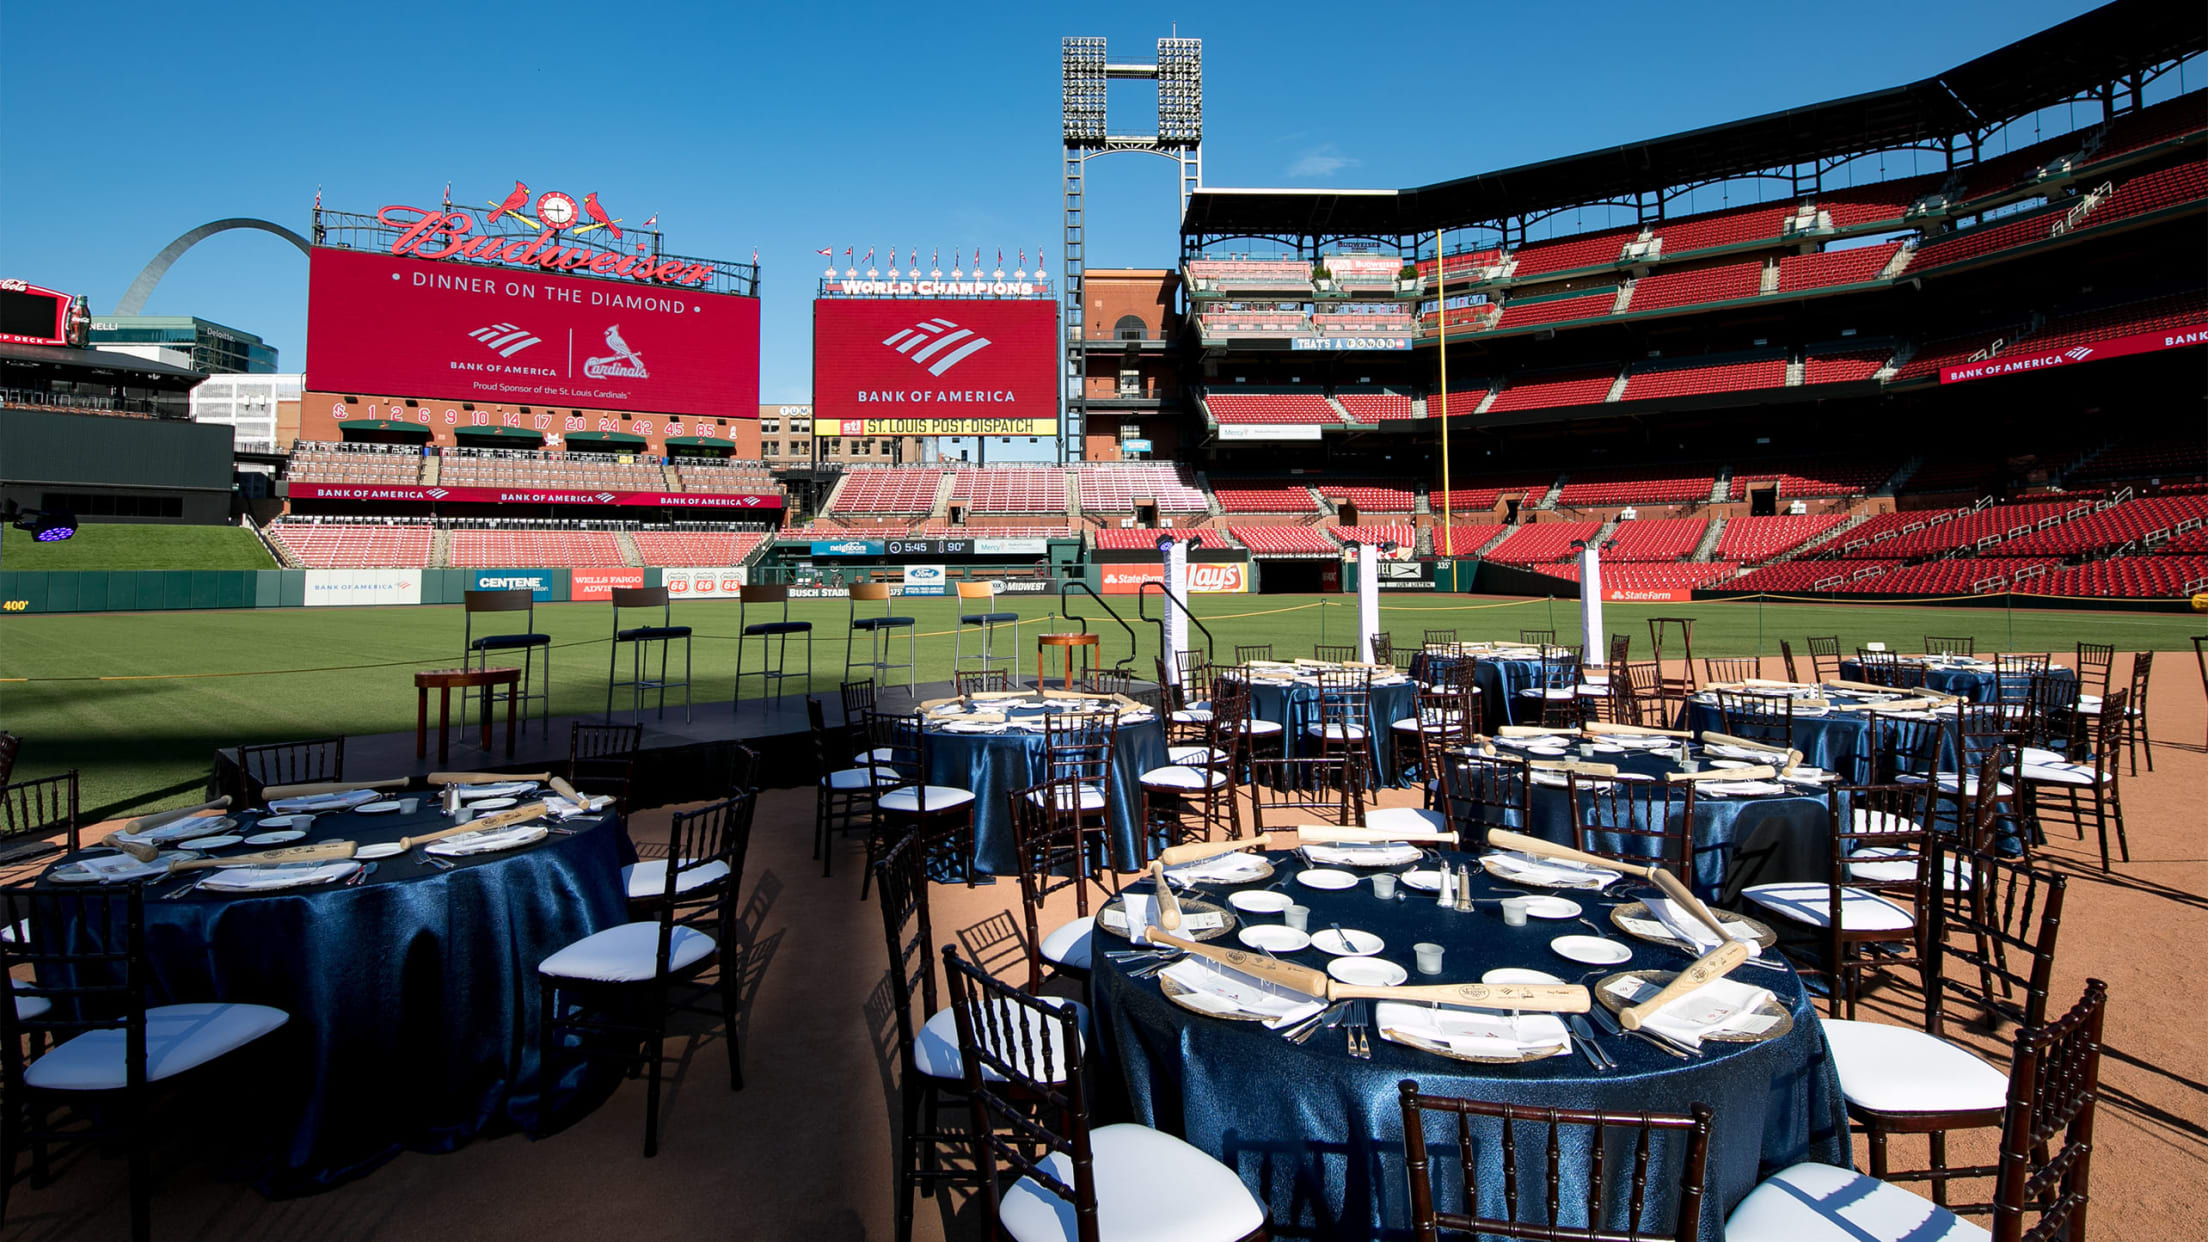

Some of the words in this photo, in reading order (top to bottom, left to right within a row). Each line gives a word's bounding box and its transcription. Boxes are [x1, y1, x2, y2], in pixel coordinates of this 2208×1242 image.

[377, 205, 714, 284] Budweiser
[841, 279, 913, 295] WORLD
[917, 280, 1034, 295] CHAMPIONS
[413, 272, 496, 294] DINNER
[505, 282, 536, 299] ON
[544, 286, 582, 303] THE
[591, 292, 685, 314] DIAMOND
[14, 336, 43, 344] DECK
[2165, 331, 2208, 346] BANK
[1297, 339, 1331, 349] THAT'S
[1335, 339, 1342, 349] A
[450, 361, 483, 371] BANK
[486, 364, 502, 372] OF
[504, 366, 557, 377] AMERICA
[583, 357, 649, 379] Cardinals
[1951, 366, 1984, 381] BANK
[1985, 364, 2002, 375] OF
[2004, 355, 2063, 372] AMERICA
[473, 381, 498, 391] Proud
[499, 383, 532, 395] Sponsor
[534, 385, 543, 394] of
[544, 386, 558, 394] the
[559, 387, 570, 396] St.
[571, 388, 592, 397] Louis
[858, 391, 905, 402] BANK
[910, 391, 932, 402] OF
[937, 390, 1015, 402] AMERICA
[368, 405, 376, 420] 1
[390, 406, 403, 422] 2
[418, 408, 431, 423] 6
[445, 409, 457, 424] 9
[472, 410, 488, 426] 10
[503, 412, 520, 428] 14
[534, 414, 552, 429] 17
[565, 416, 586, 432] 20
[598, 418, 619, 433] 24
[632, 420, 652, 435] 42
[664, 421, 684, 437] 45
[696, 423, 715, 438] 85
[867, 419, 886, 433] ST.
[889, 419, 927, 433] LOUIS
[932, 418, 1034, 433] POST-DISPATCH
[317, 489, 351, 497] BANK
[353, 489, 369, 497] OF
[370, 490, 424, 499] AMERICA
[501, 493, 530, 501] BANK
[547, 495, 594, 503] AMERICA
[660, 497, 686, 505] BANK
[701, 498, 742, 506] AMERICA
[830, 543, 866, 552] neighbors
[904, 543, 927, 552] 5:45
[947, 542, 965, 551] 90°
[981, 543, 1001, 551] Mercy
[575, 576, 609, 584] WELLS
[610, 576, 642, 584] FARGO
[1187, 564, 1238, 591] Lay's
[479, 577, 541, 589] CENTENE
[671, 581, 686, 590] 66
[697, 581, 713, 590] 66
[724, 581, 738, 589] 66
[1007, 582, 1046, 591] MIDWEST
[789, 588, 818, 597] BUSCH
[2, 600, 29, 611] 400'
